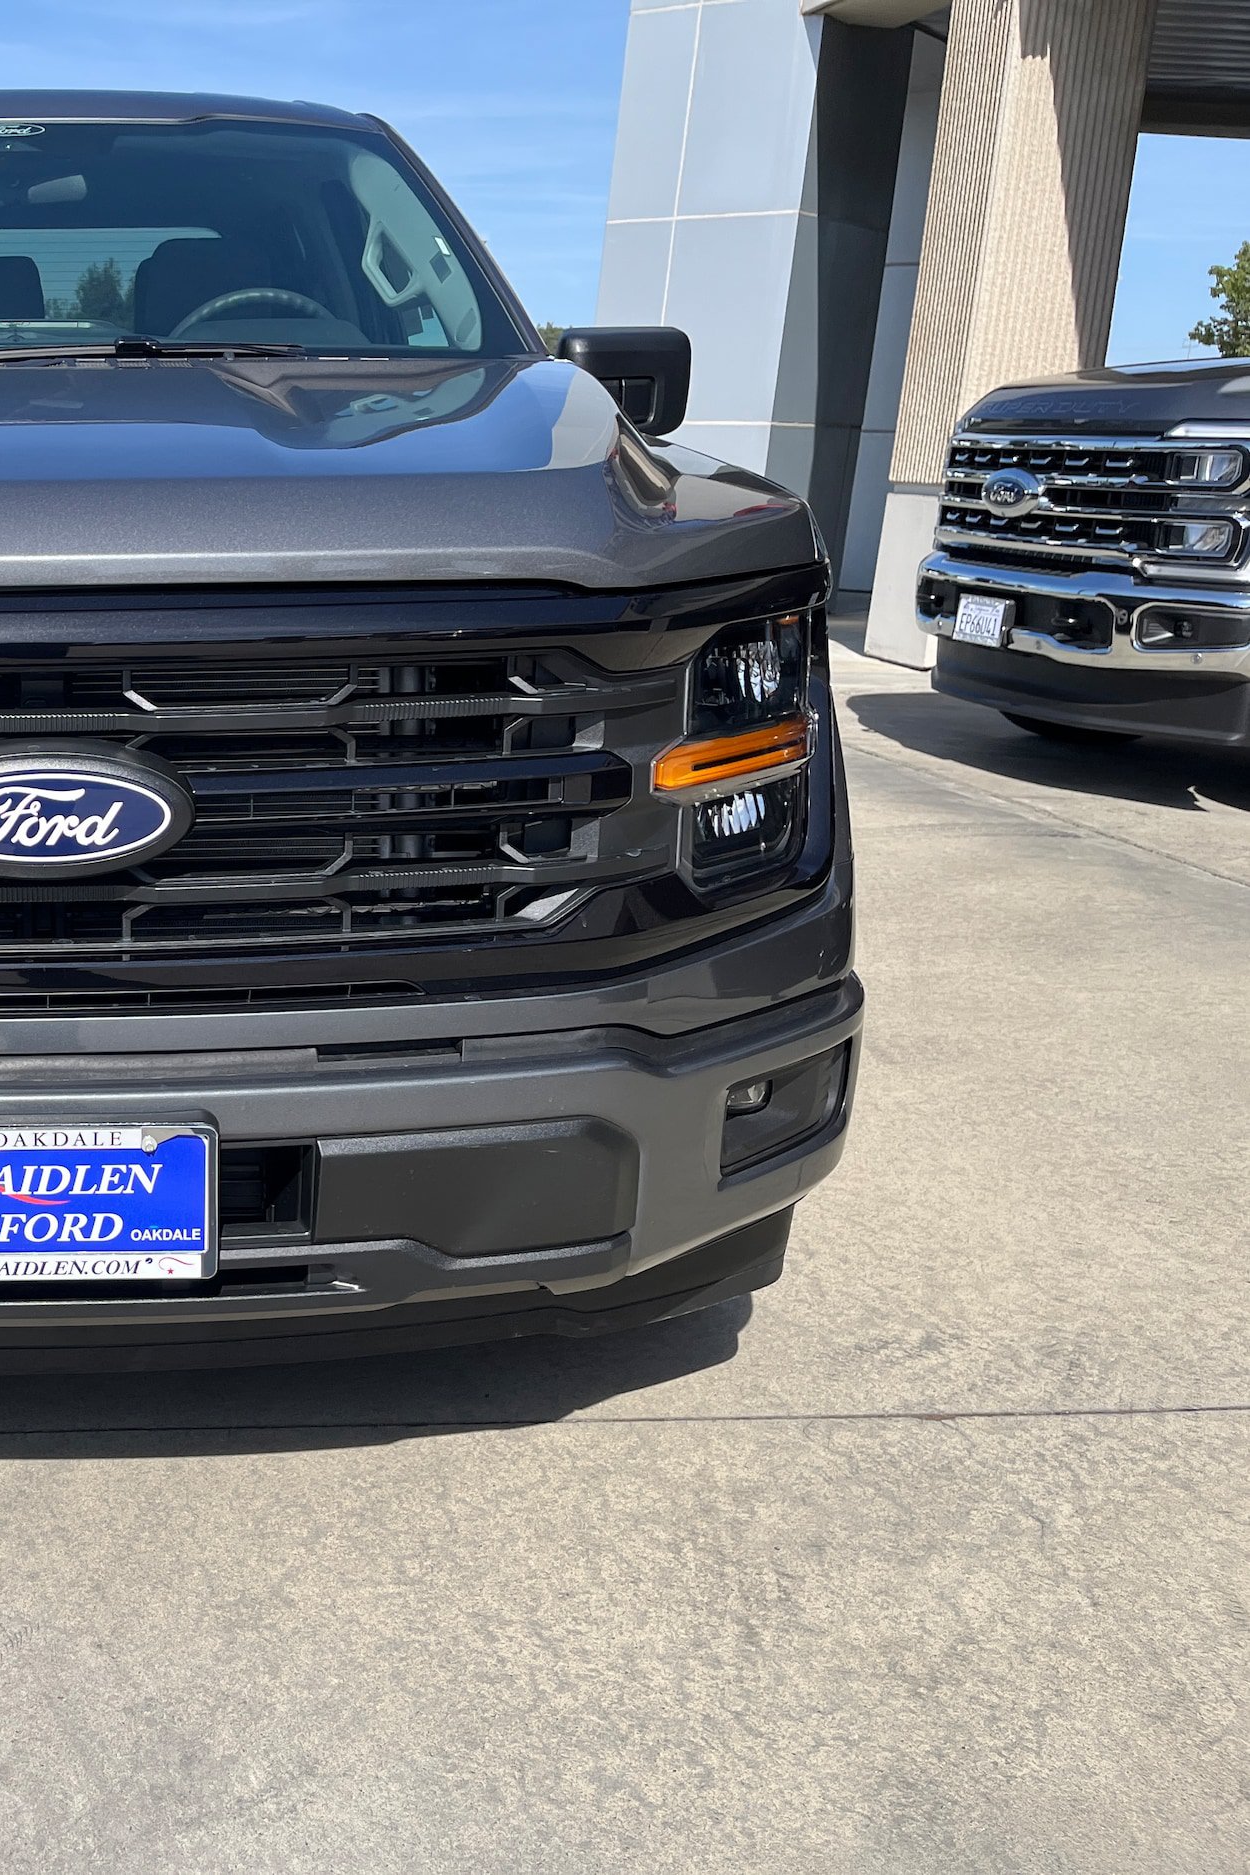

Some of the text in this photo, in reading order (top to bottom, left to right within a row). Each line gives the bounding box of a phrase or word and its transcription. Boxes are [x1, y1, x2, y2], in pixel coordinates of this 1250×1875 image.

[1053, 400, 1141, 414] DUTY
[958, 612, 997, 637] EP66U41
[130, 1227, 201, 1242] OAKDALE
